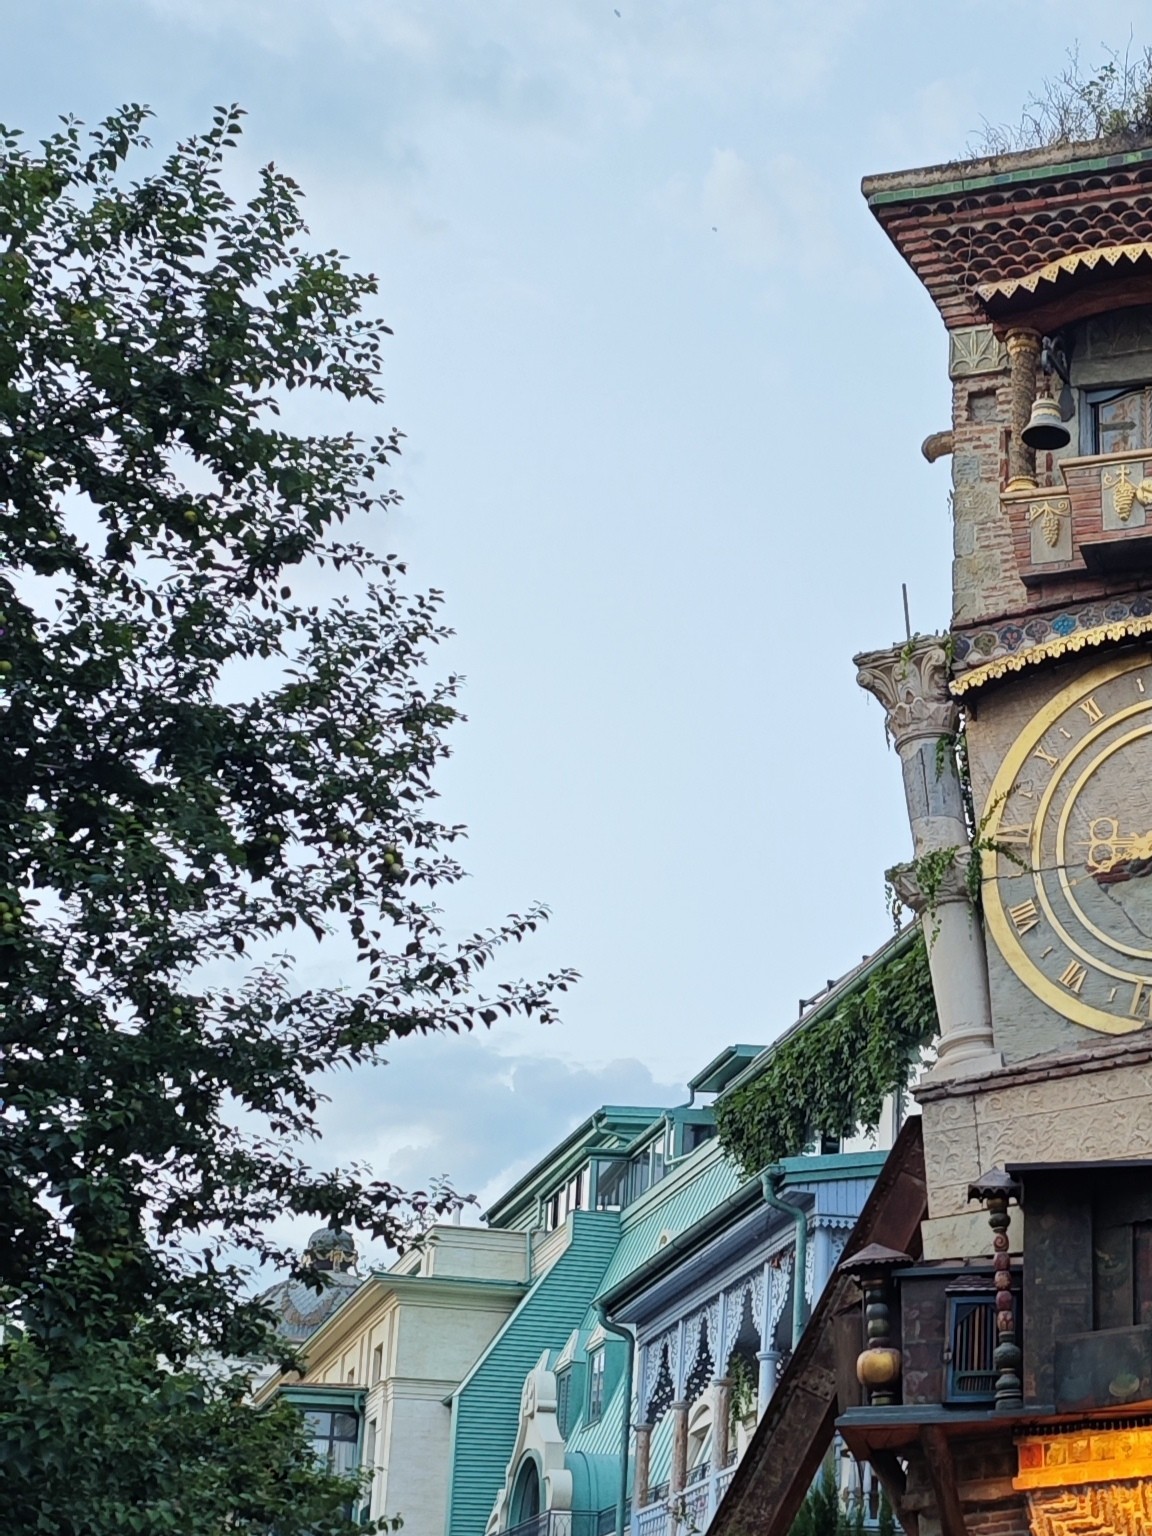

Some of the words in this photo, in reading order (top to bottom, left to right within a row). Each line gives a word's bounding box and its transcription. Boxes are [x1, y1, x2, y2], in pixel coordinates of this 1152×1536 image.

[1079, 696, 1106, 726] XI
[1033, 745, 1059, 768] X
[1008, 899, 1040, 937] VIII
[1057, 959, 1088, 993] VII
